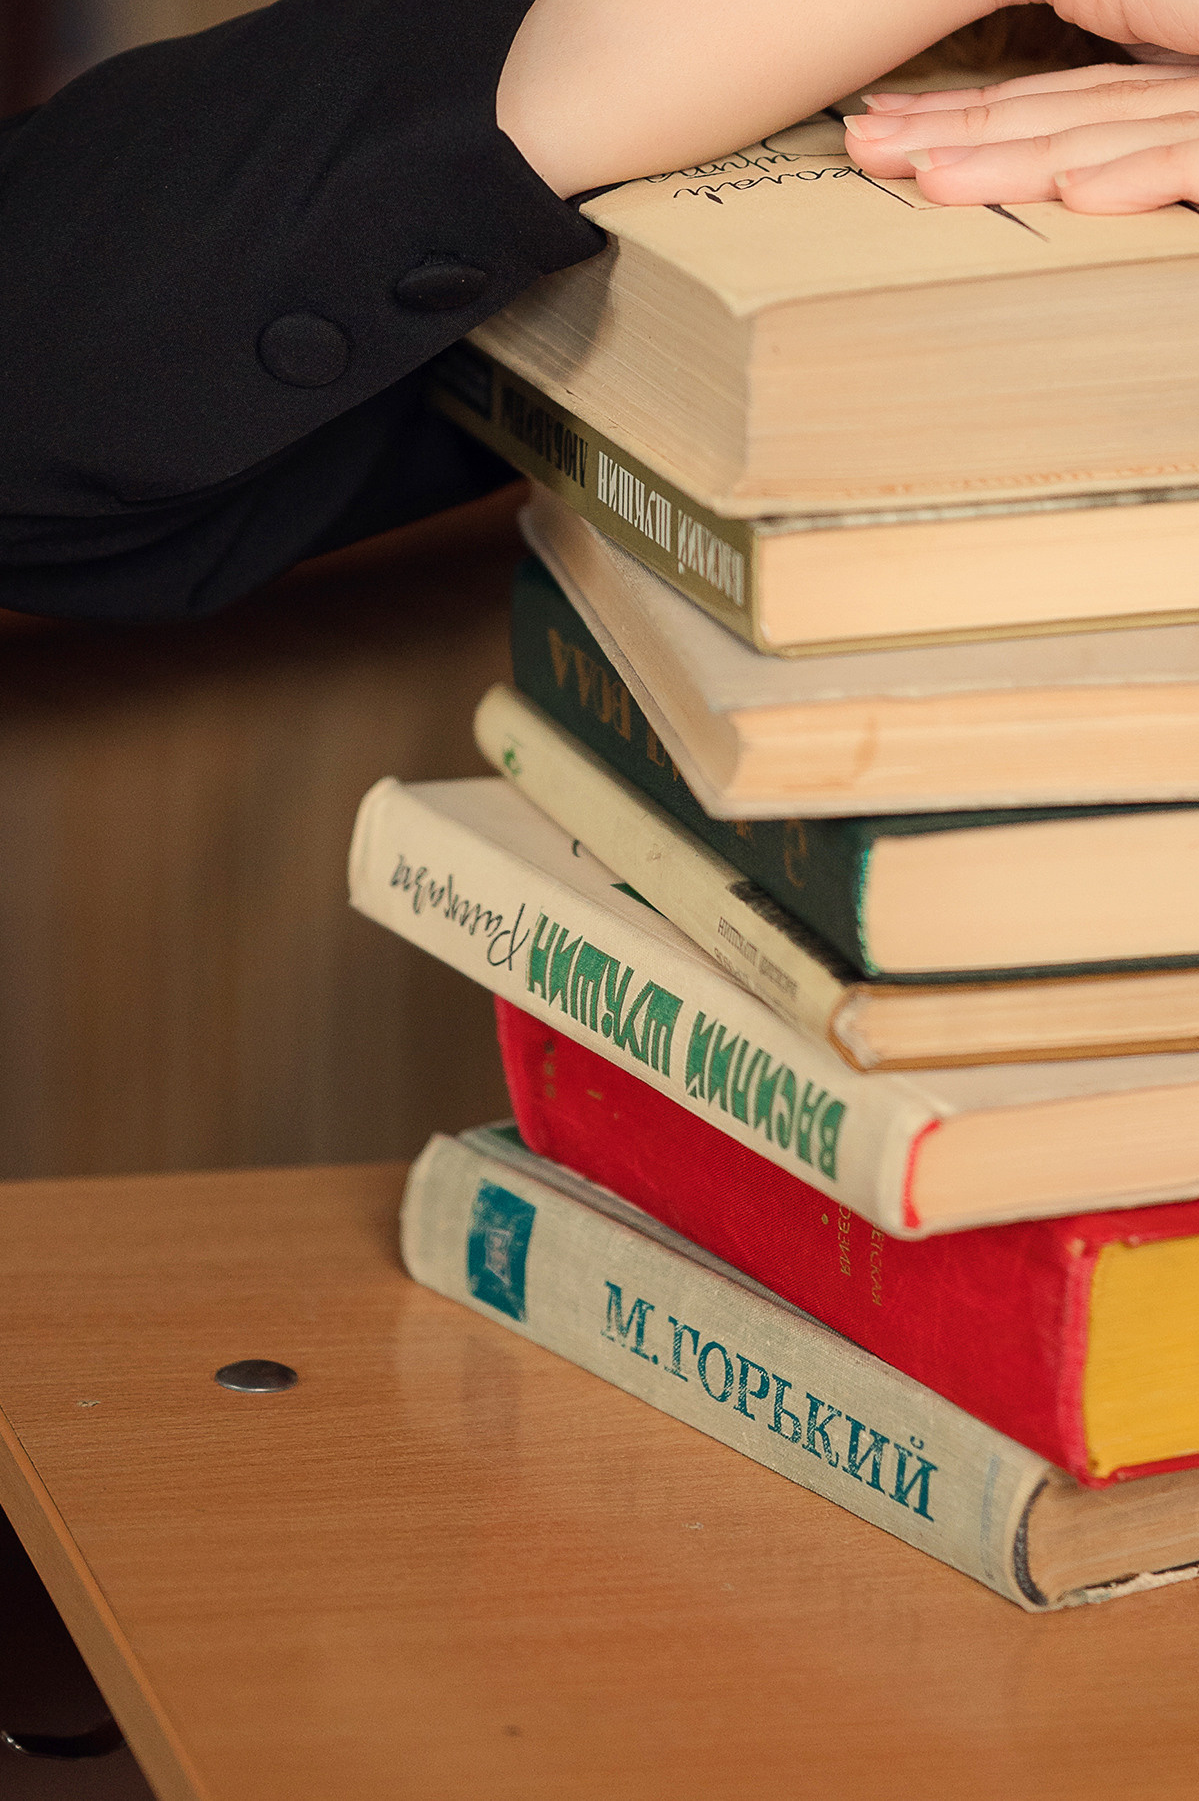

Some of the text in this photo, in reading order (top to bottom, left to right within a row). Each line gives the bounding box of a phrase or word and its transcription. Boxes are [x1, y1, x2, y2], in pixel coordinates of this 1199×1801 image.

[597, 451, 672, 553] ШУКШИН
[676, 509, 745, 607] ВАСИЛИЙ
[526, 910, 684, 1076] ШУКШИН
[685, 1010, 848, 1181] ВАСИЛИЙ
[838, 1204, 852, 1277] ОЭЗИЯ
